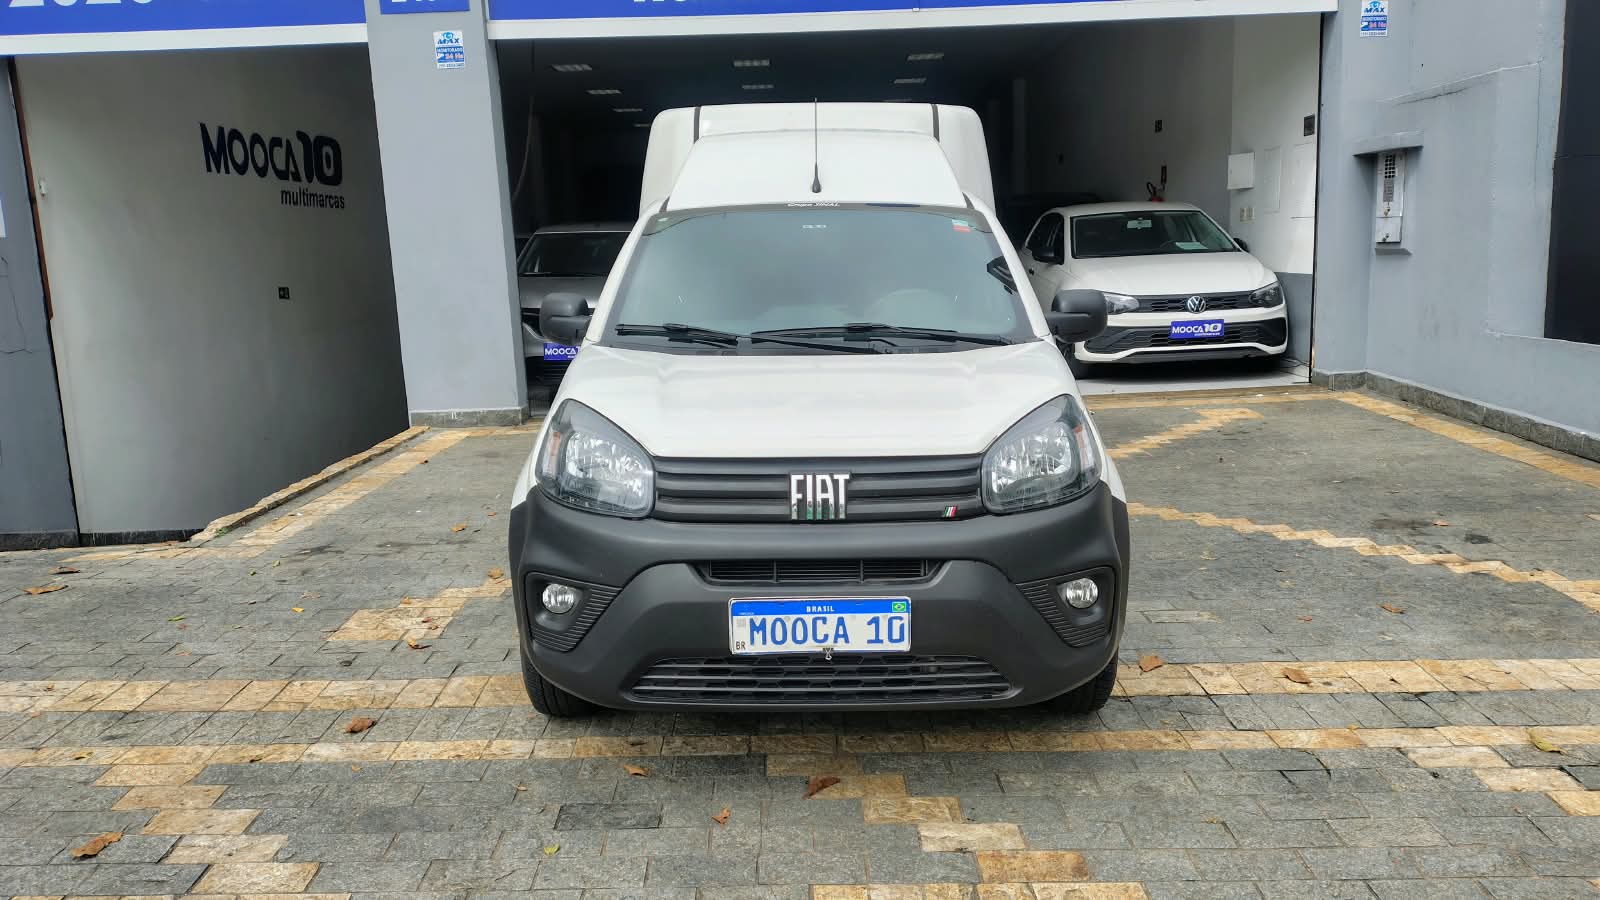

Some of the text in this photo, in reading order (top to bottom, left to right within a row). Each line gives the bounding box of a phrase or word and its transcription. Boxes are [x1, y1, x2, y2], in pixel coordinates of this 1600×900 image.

[281, 187, 345, 208] multimarcas
[544, 346, 581, 355] MOOCA1
[791, 474, 850, 519] FIAT
[806, 605, 835, 613] BRASIL
[750, 616, 905, 646] MOOCA 10
[735, 641, 746, 650] BR
